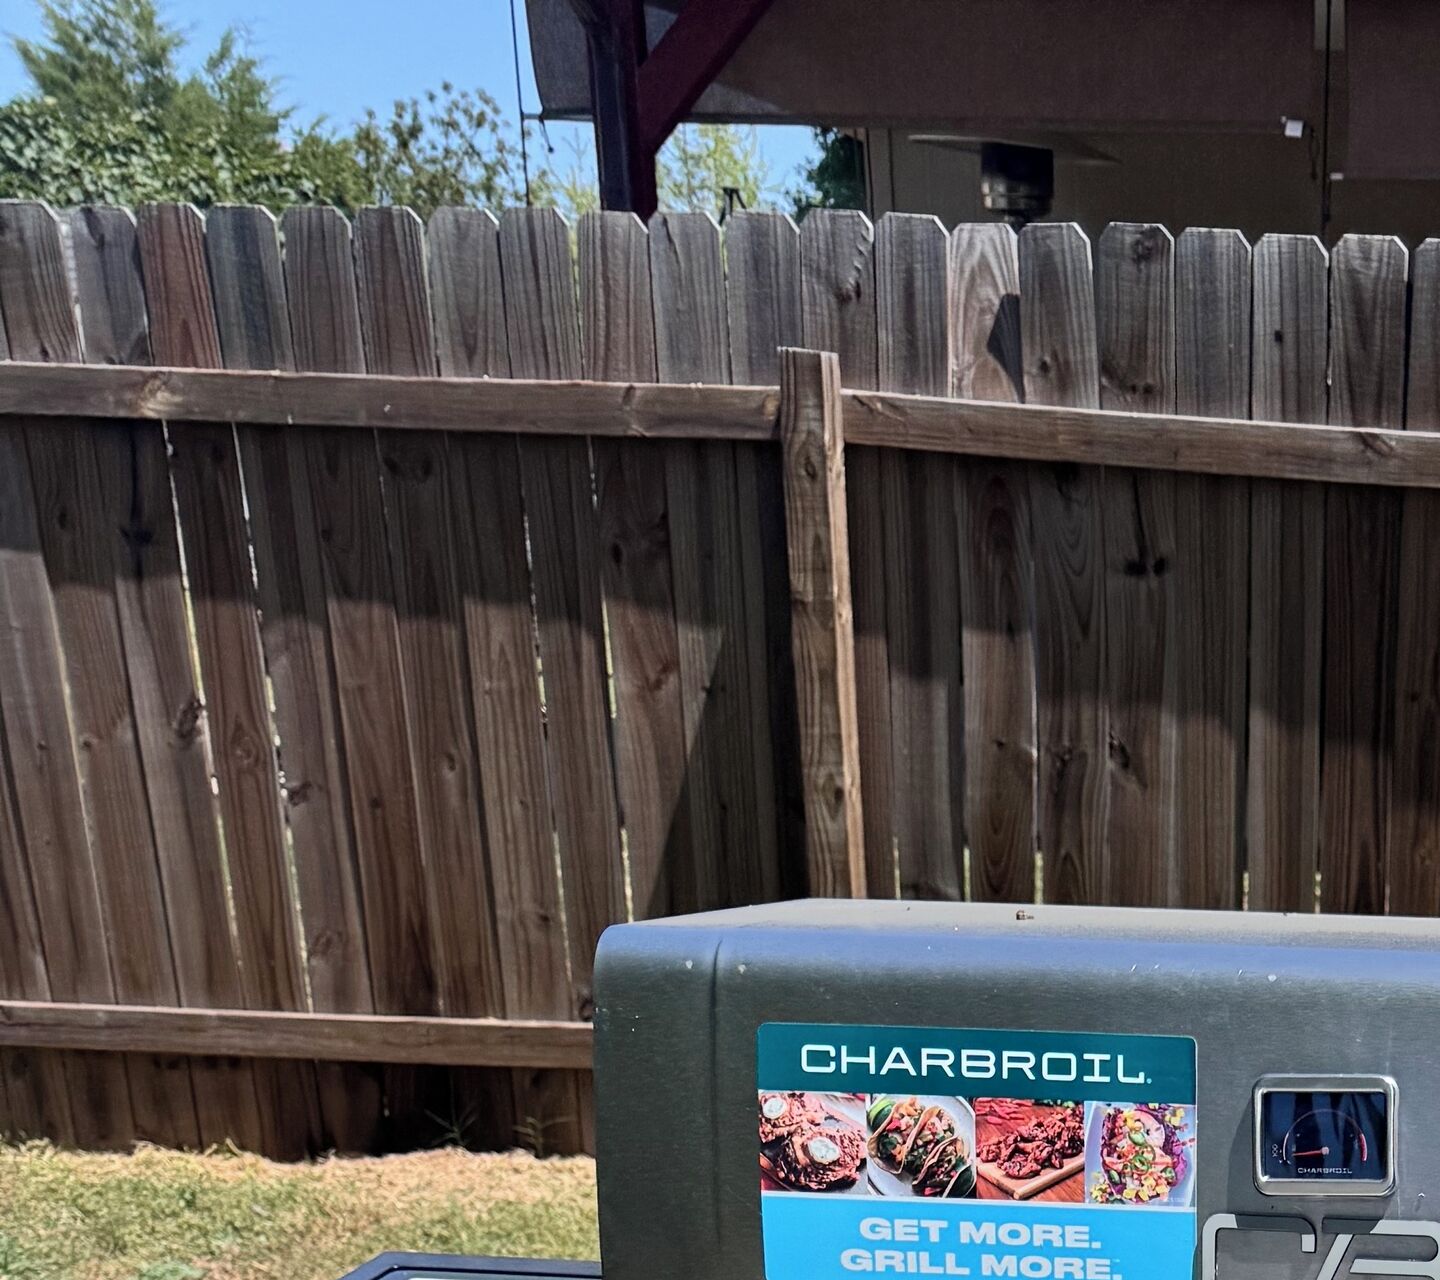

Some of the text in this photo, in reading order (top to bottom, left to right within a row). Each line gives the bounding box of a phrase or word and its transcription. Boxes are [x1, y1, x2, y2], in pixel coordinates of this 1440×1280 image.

[859, 1217, 1102, 1249] GET MORE.
[840, 1249, 970, 1276] GRILL
